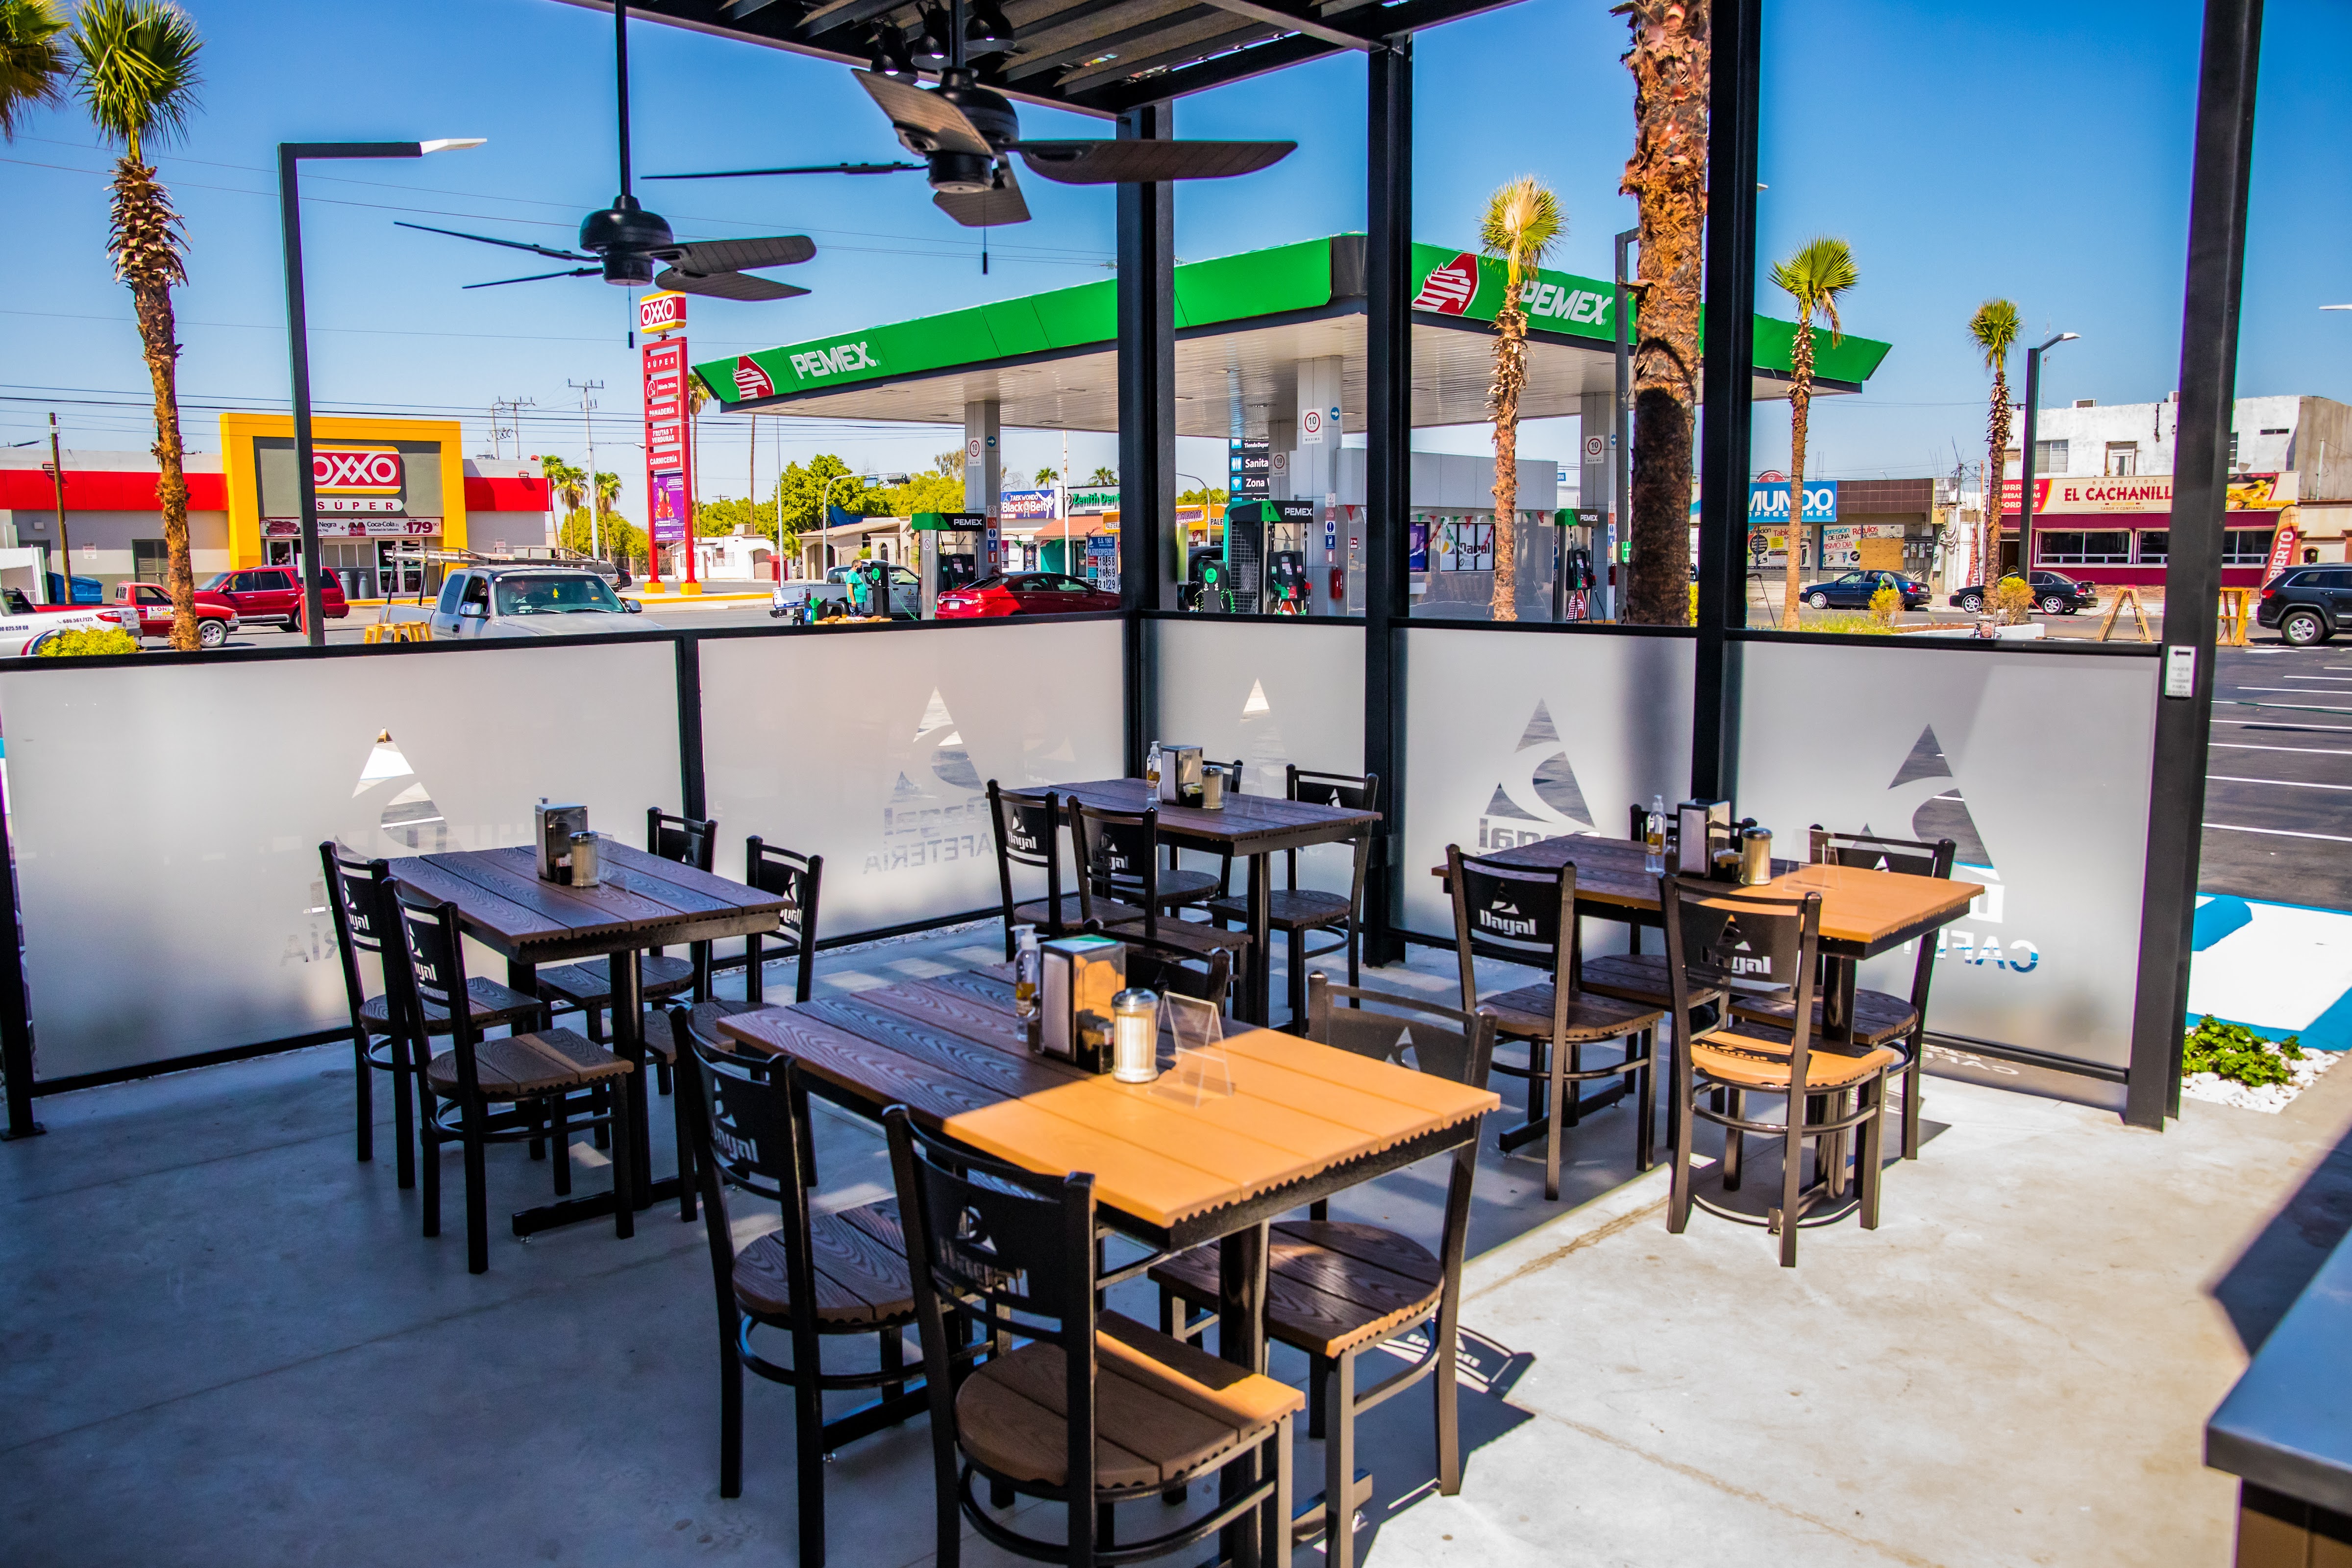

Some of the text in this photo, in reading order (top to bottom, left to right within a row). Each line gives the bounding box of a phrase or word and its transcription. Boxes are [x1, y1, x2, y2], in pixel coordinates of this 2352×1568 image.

[1518, 279, 1613, 325] PEMEX
[642, 298, 674, 325] OXXO
[647, 357, 674, 369] SÚPER
[790, 342, 877, 379] PEMEX
[649, 406, 674, 417] PANADERÍA
[652, 435, 675, 443] VERDURAS
[649, 454, 678, 465] CARNICERÍA
[1245, 458, 1268, 468] Sanita
[313, 454, 396, 486] OXXO
[1246, 478, 1264, 487] Zona
[1073, 493, 1099, 504] Zenith
[2064, 486, 2173, 501] EL CACHANILL
[317, 499, 394, 510] SÚPER
[1003, 501, 1046, 512] Black Belt
[1267, 506, 1271, 515] 1
[1480, 909, 1537, 936] Dagal
